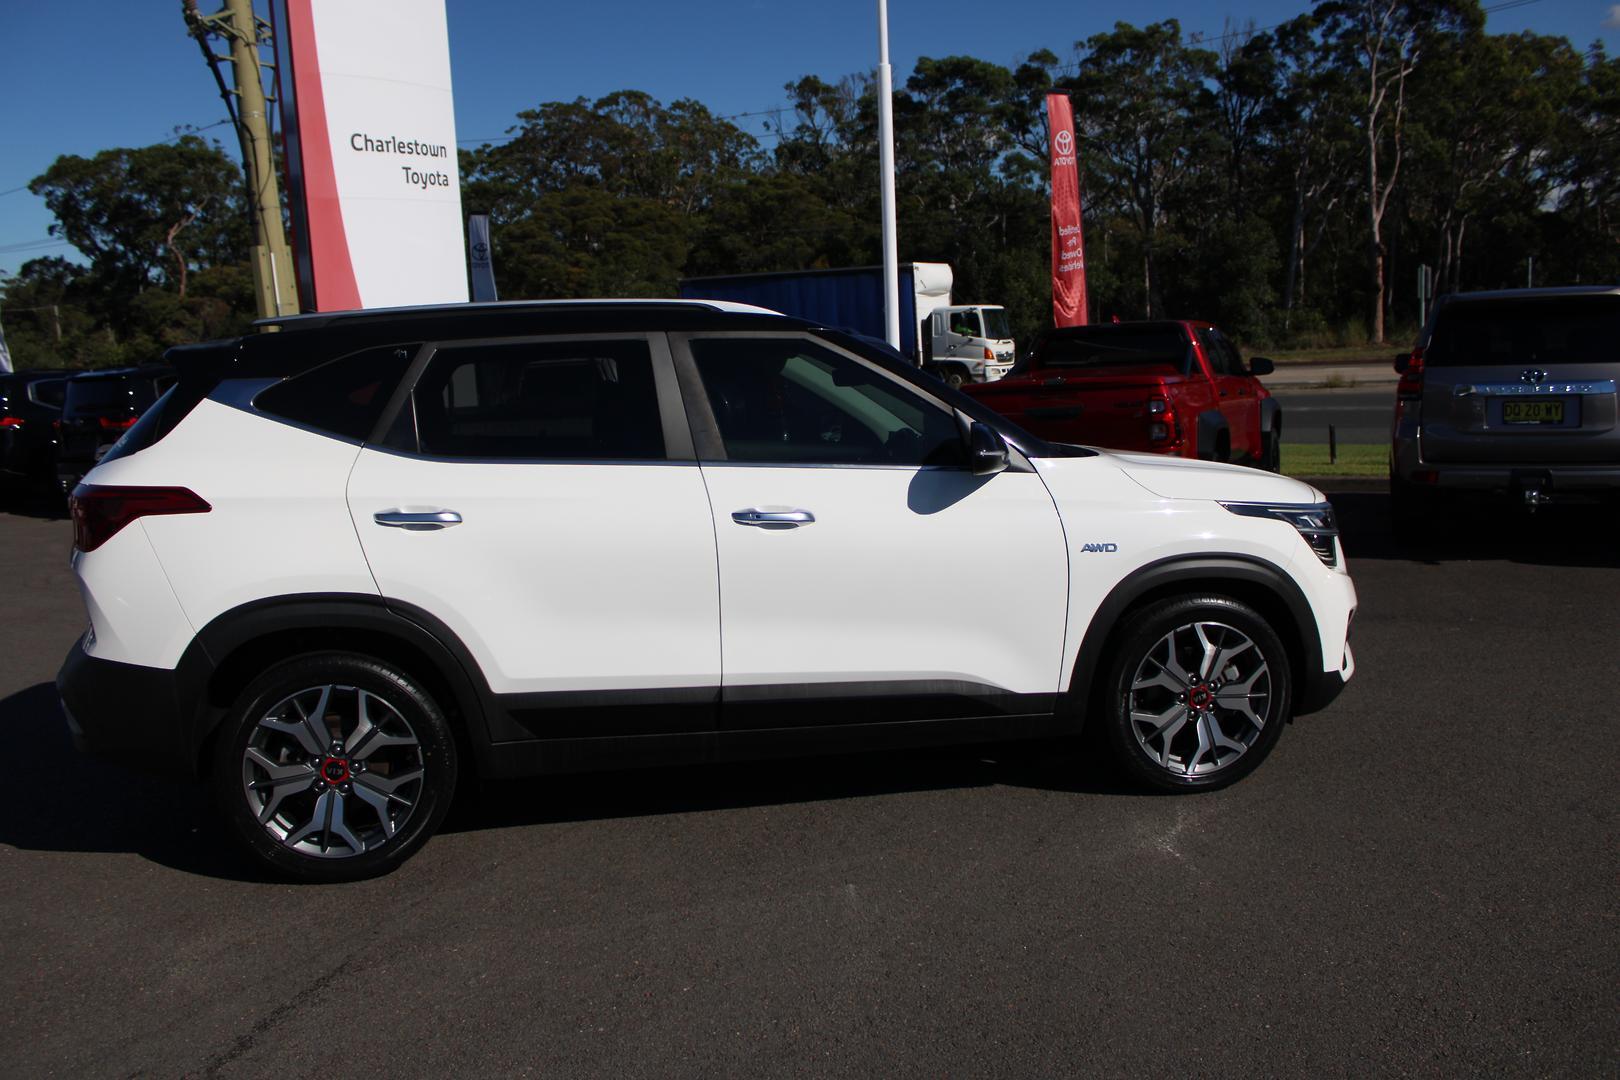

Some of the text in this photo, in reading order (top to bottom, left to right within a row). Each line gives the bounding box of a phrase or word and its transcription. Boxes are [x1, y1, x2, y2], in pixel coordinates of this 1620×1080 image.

[350, 133, 447, 158] Charlestown
[401, 166, 449, 190] Toyota
[1080, 543, 1118, 553] AWD
